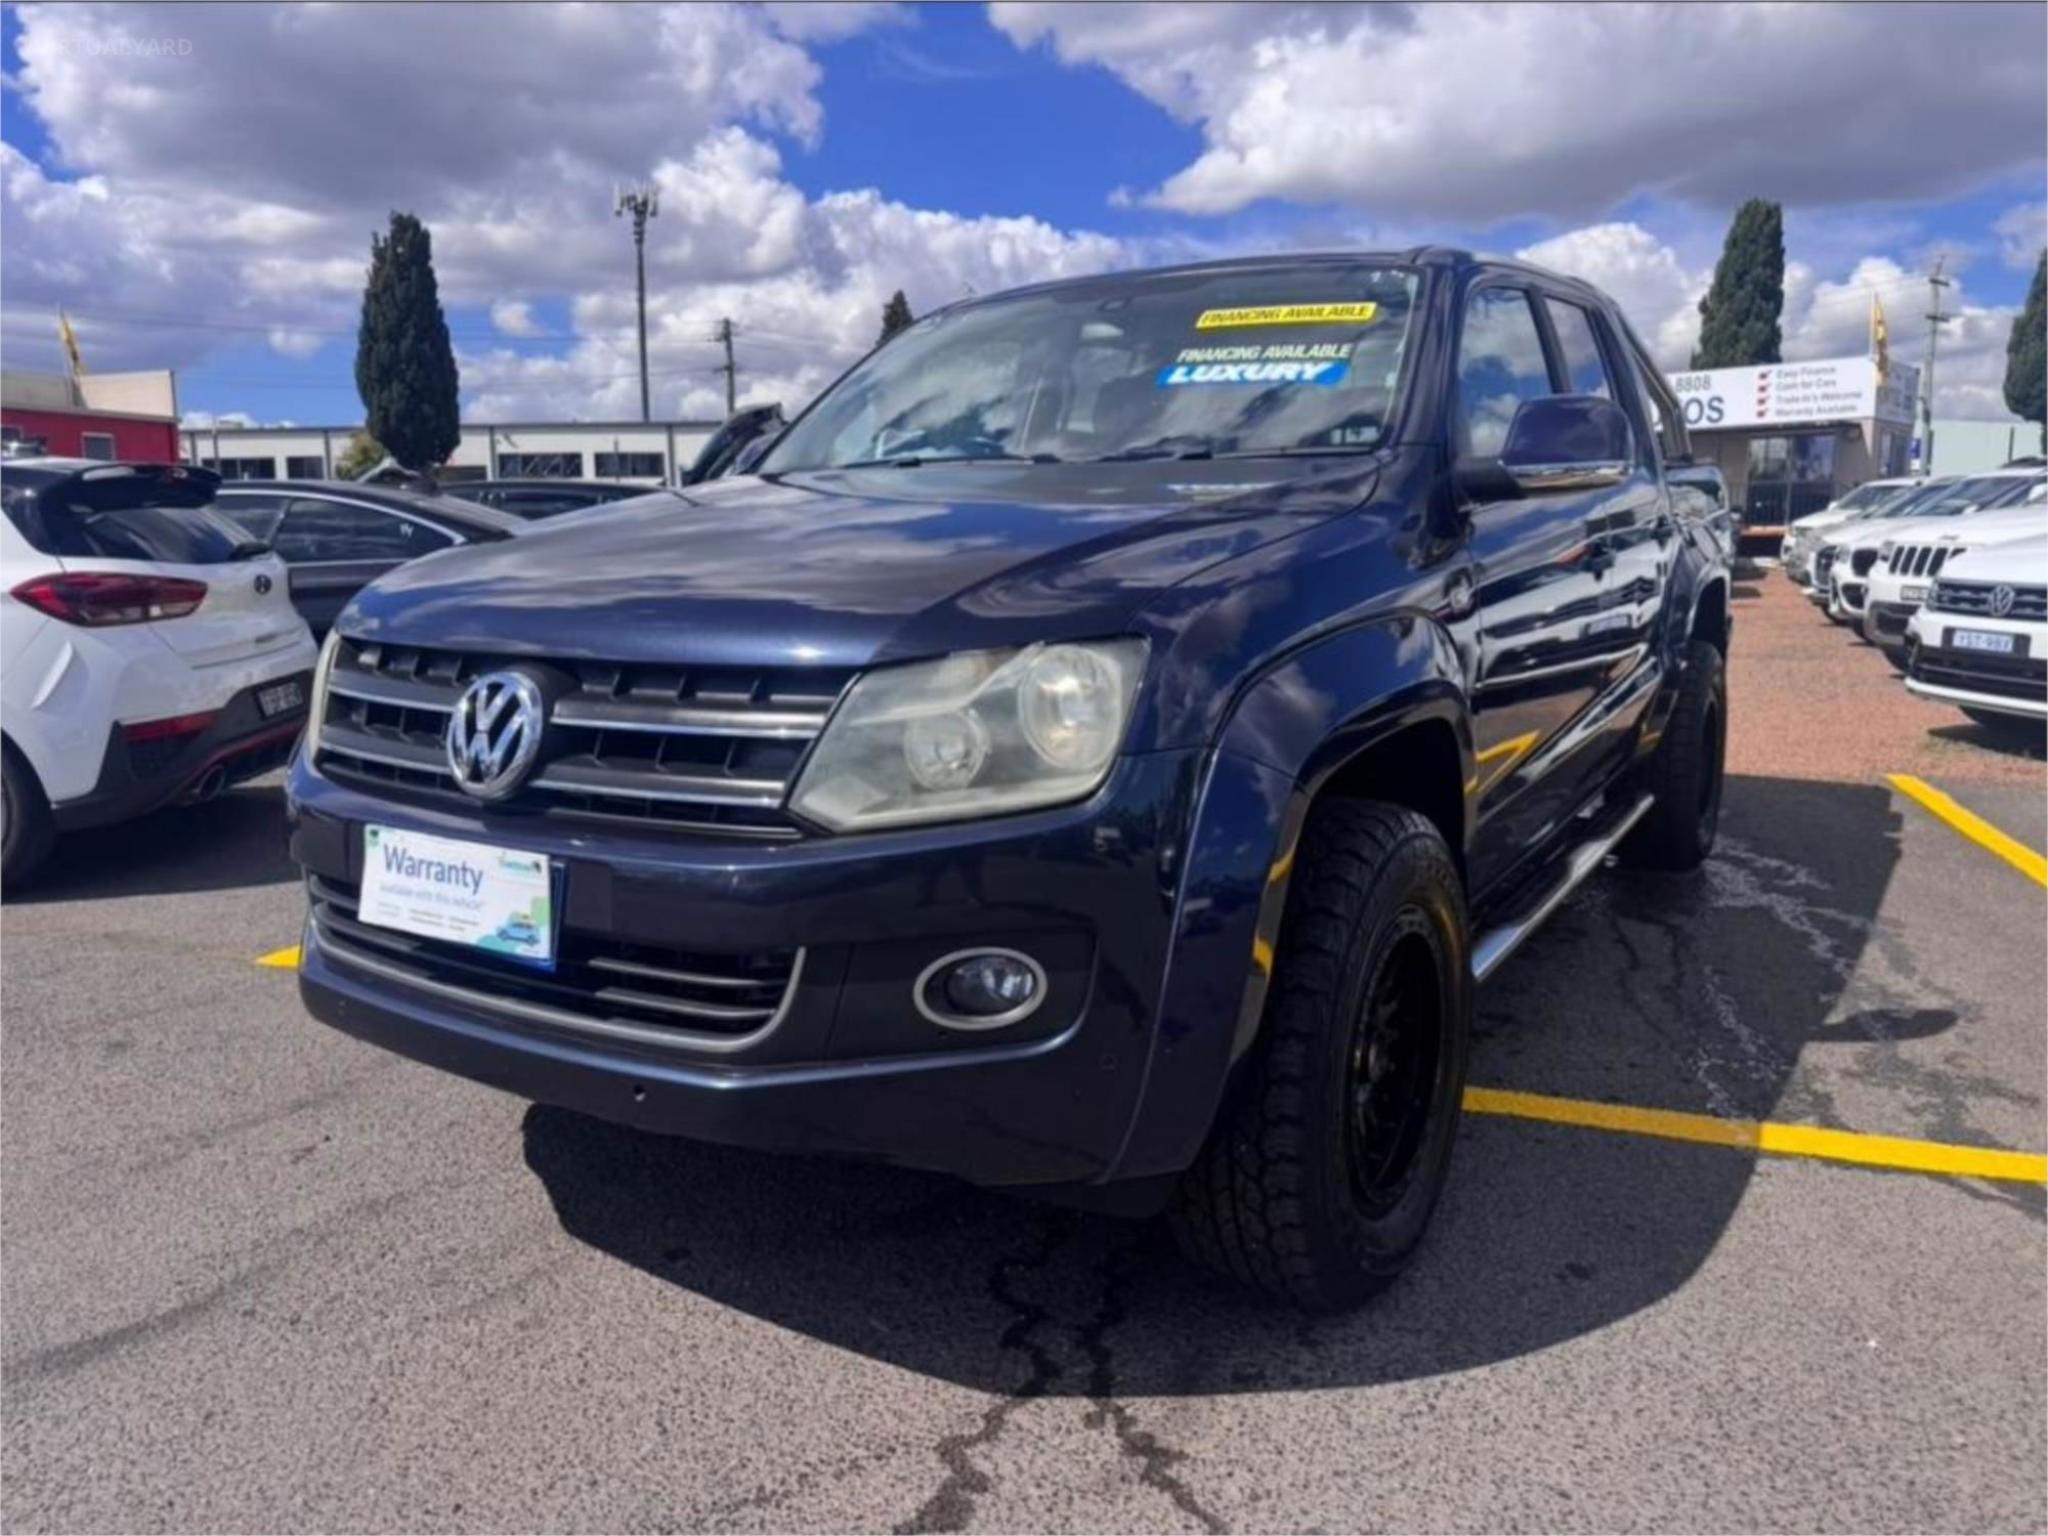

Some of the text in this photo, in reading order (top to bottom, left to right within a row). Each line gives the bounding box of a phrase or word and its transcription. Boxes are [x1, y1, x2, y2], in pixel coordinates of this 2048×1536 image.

[1203, 304, 1369, 324] FINANCING AVAILABLE
[1176, 343, 1353, 363] FINANCING AVAILABLE
[1166, 361, 1333, 383] LUXURY
[382, 843, 484, 895] Warranty
